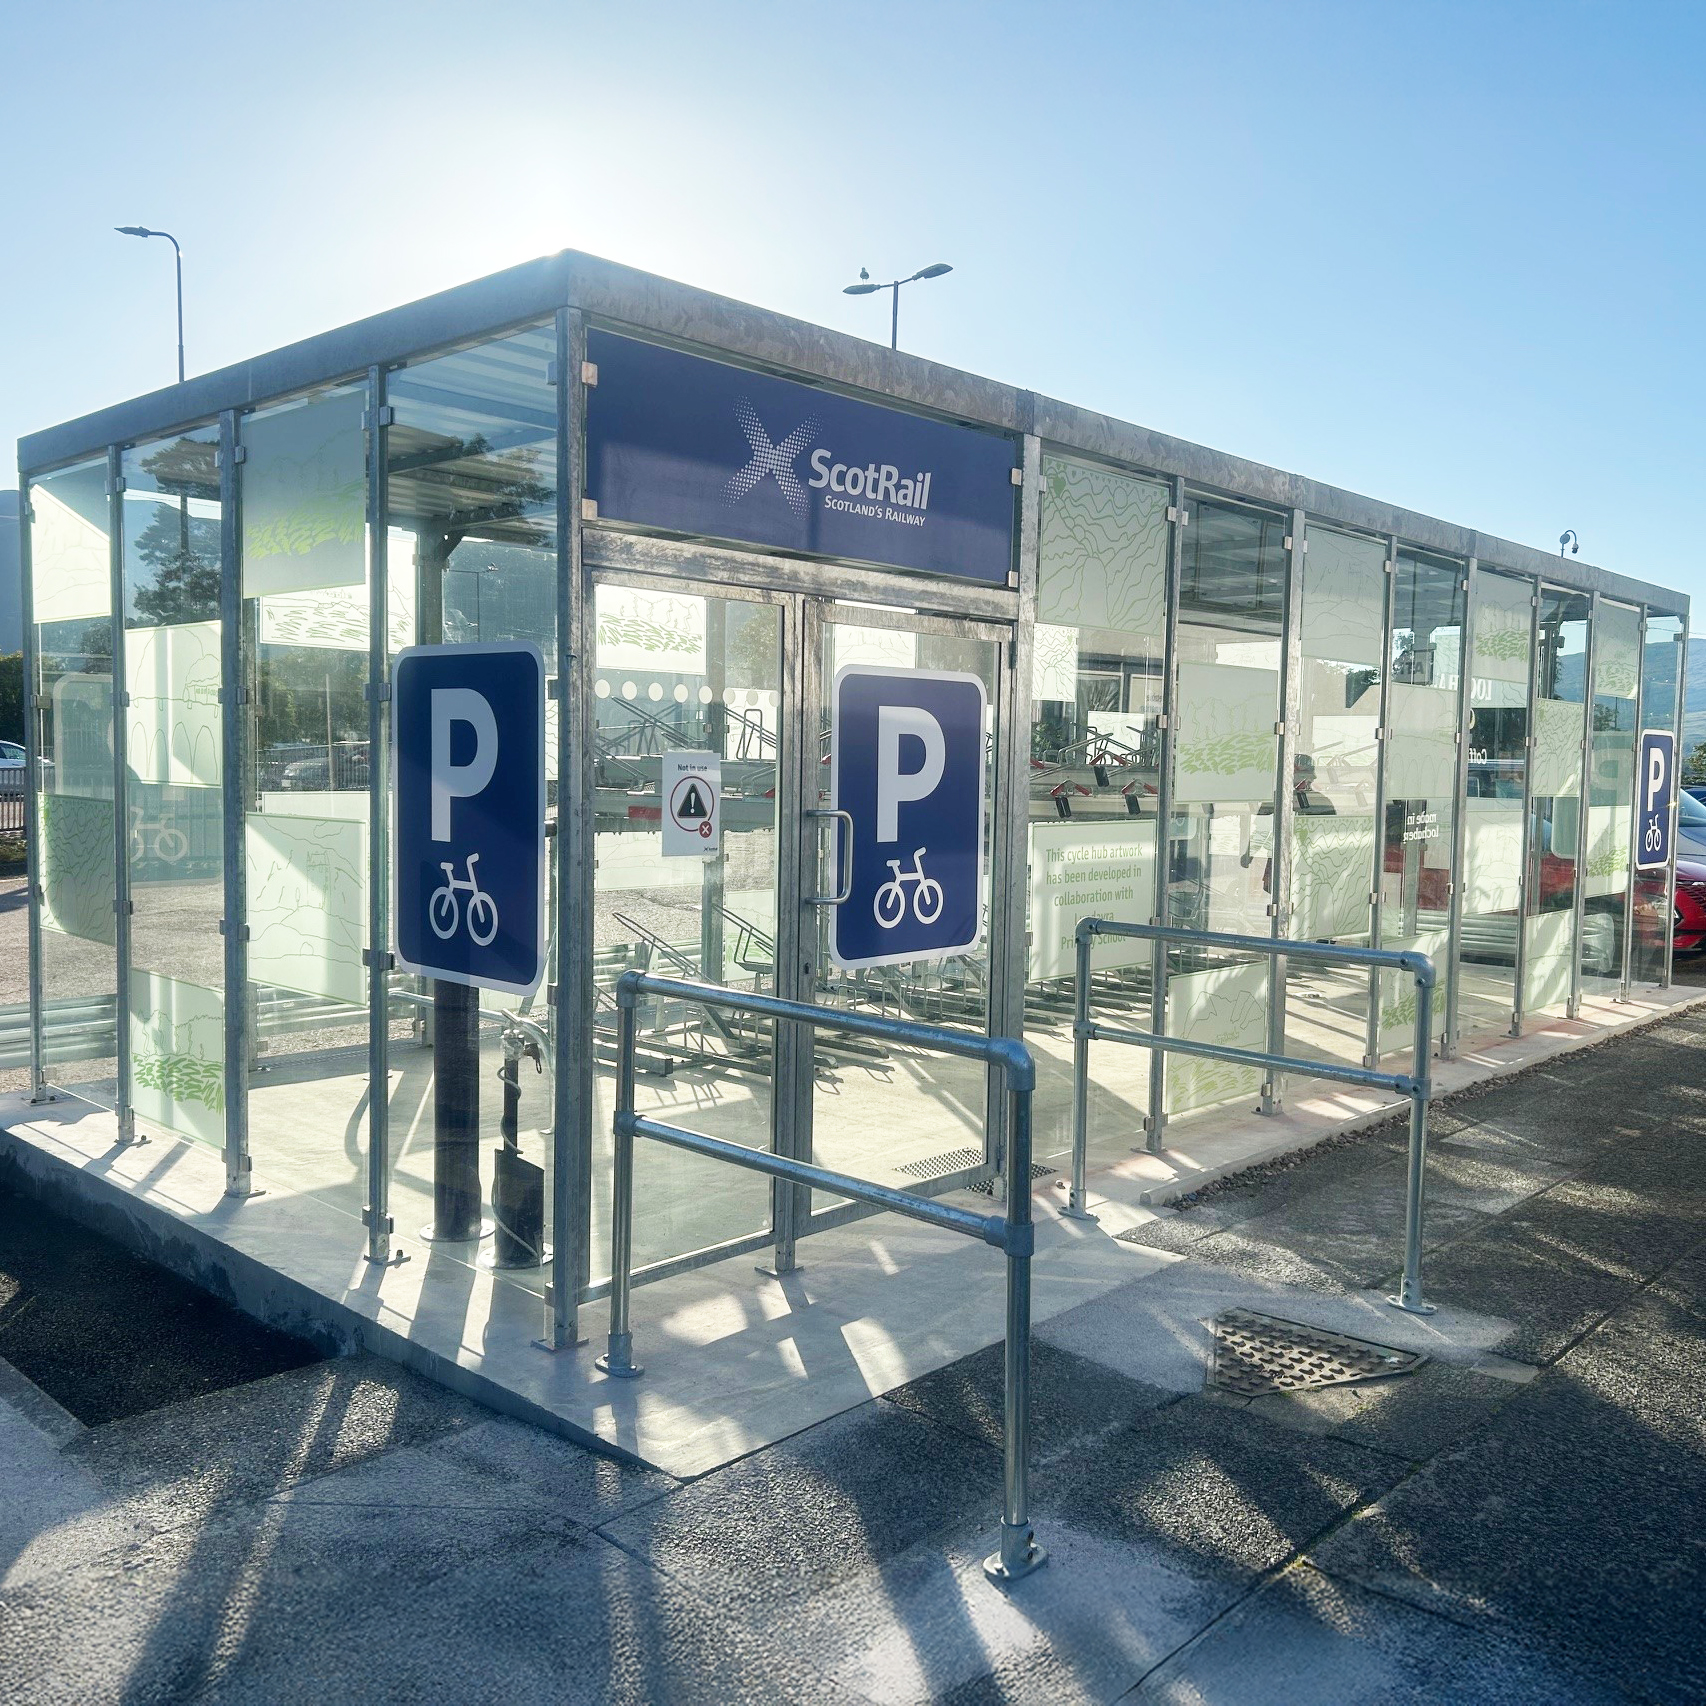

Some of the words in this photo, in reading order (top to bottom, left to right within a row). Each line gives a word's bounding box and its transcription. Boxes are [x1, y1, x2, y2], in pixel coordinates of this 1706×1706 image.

[808, 448, 932, 510] ScotRail
[431, 688, 499, 843] P
[677, 763, 689, 771] Not
[689, 763, 696, 771] in
[696, 764, 708, 772] use
[876, 705, 946, 843] P
[1647, 747, 1665, 812] P
[1046, 848, 1065, 863] This
[1067, 846, 1089, 865] cycle
[1091, 843, 1108, 860] hub
[1109, 843, 1143, 858] artwork
[1046, 870, 1062, 885] has
[1064, 868, 1086, 883] been
[1088, 865, 1132, 883] developed
[1133, 864, 1142, 878] in
[1054, 888, 1113, 907] collaboration
[1114, 885, 1134, 901] with
